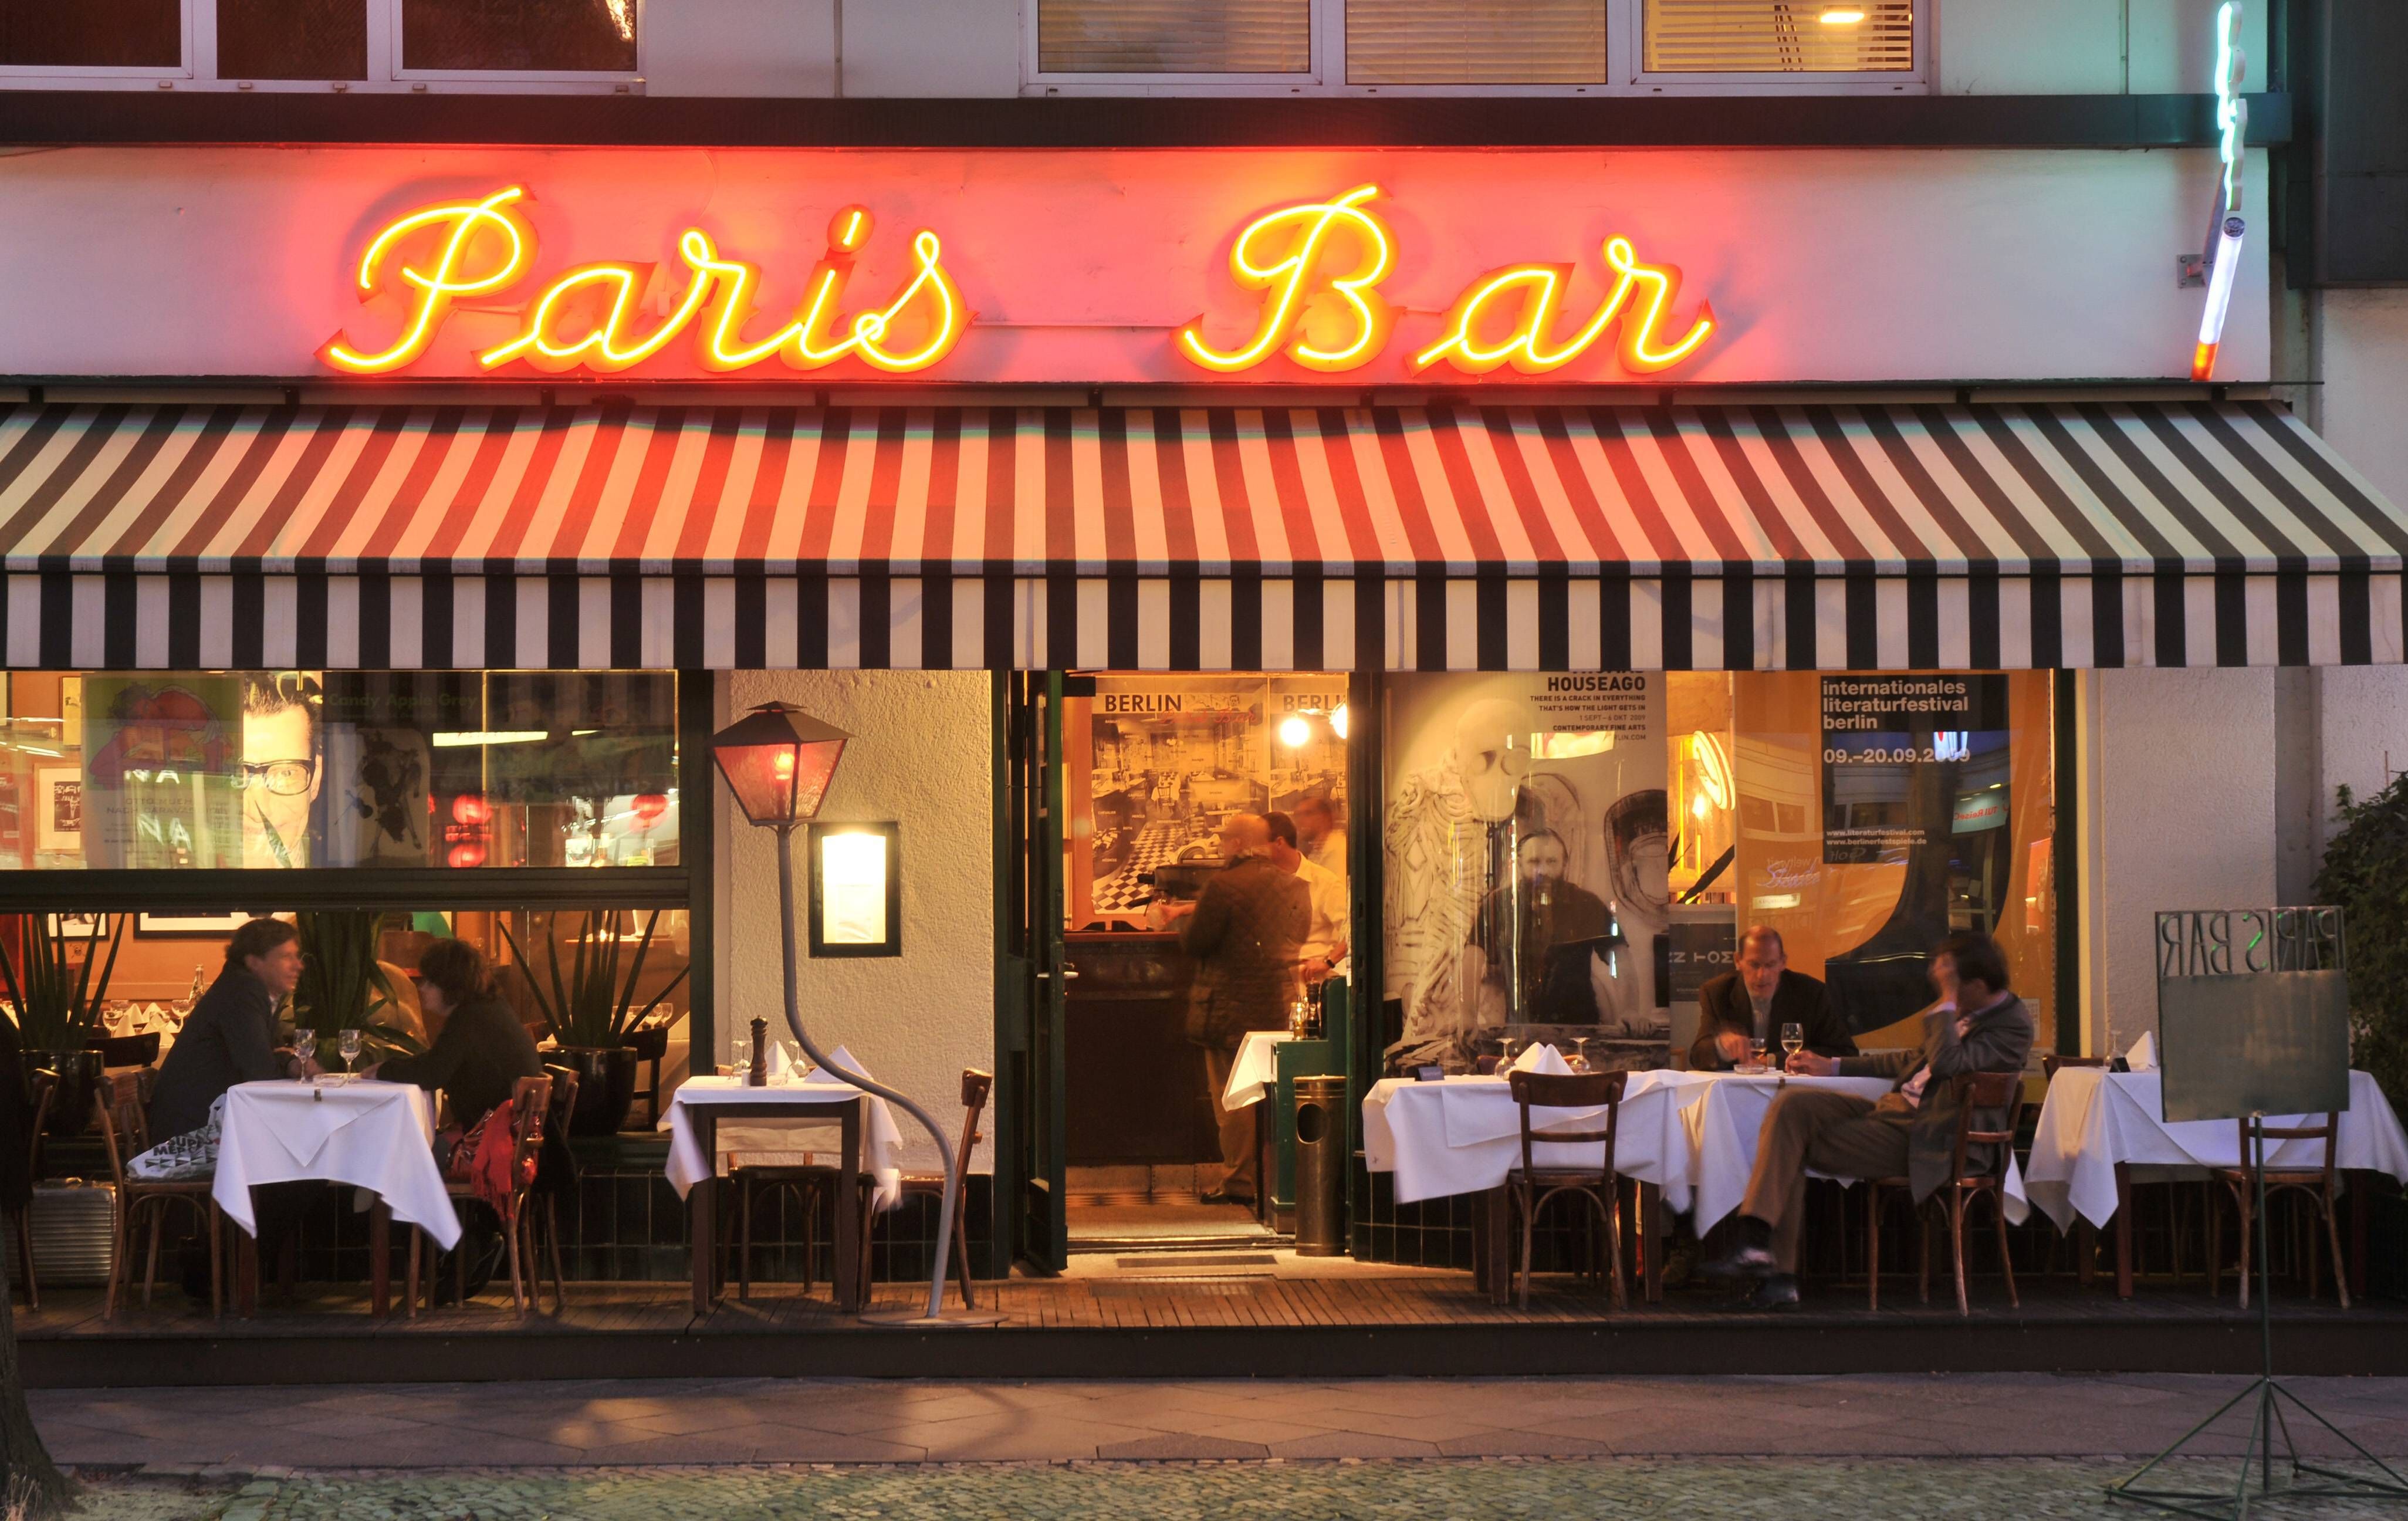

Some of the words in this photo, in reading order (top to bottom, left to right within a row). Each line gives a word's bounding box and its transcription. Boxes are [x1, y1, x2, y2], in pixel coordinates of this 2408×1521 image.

[320, 184, 968, 372] Paris
[1176, 182, 1714, 373] Bar
[1548, 676, 1646, 691] HOUSEAGO
[1822, 680, 1966, 695] internationales
[1105, 694, 1182, 712] BERLIN
[1283, 694, 1345, 712] BERLI
[1822, 696, 1969, 712] literaturfestival
[1823, 714, 1878, 729] berlin
